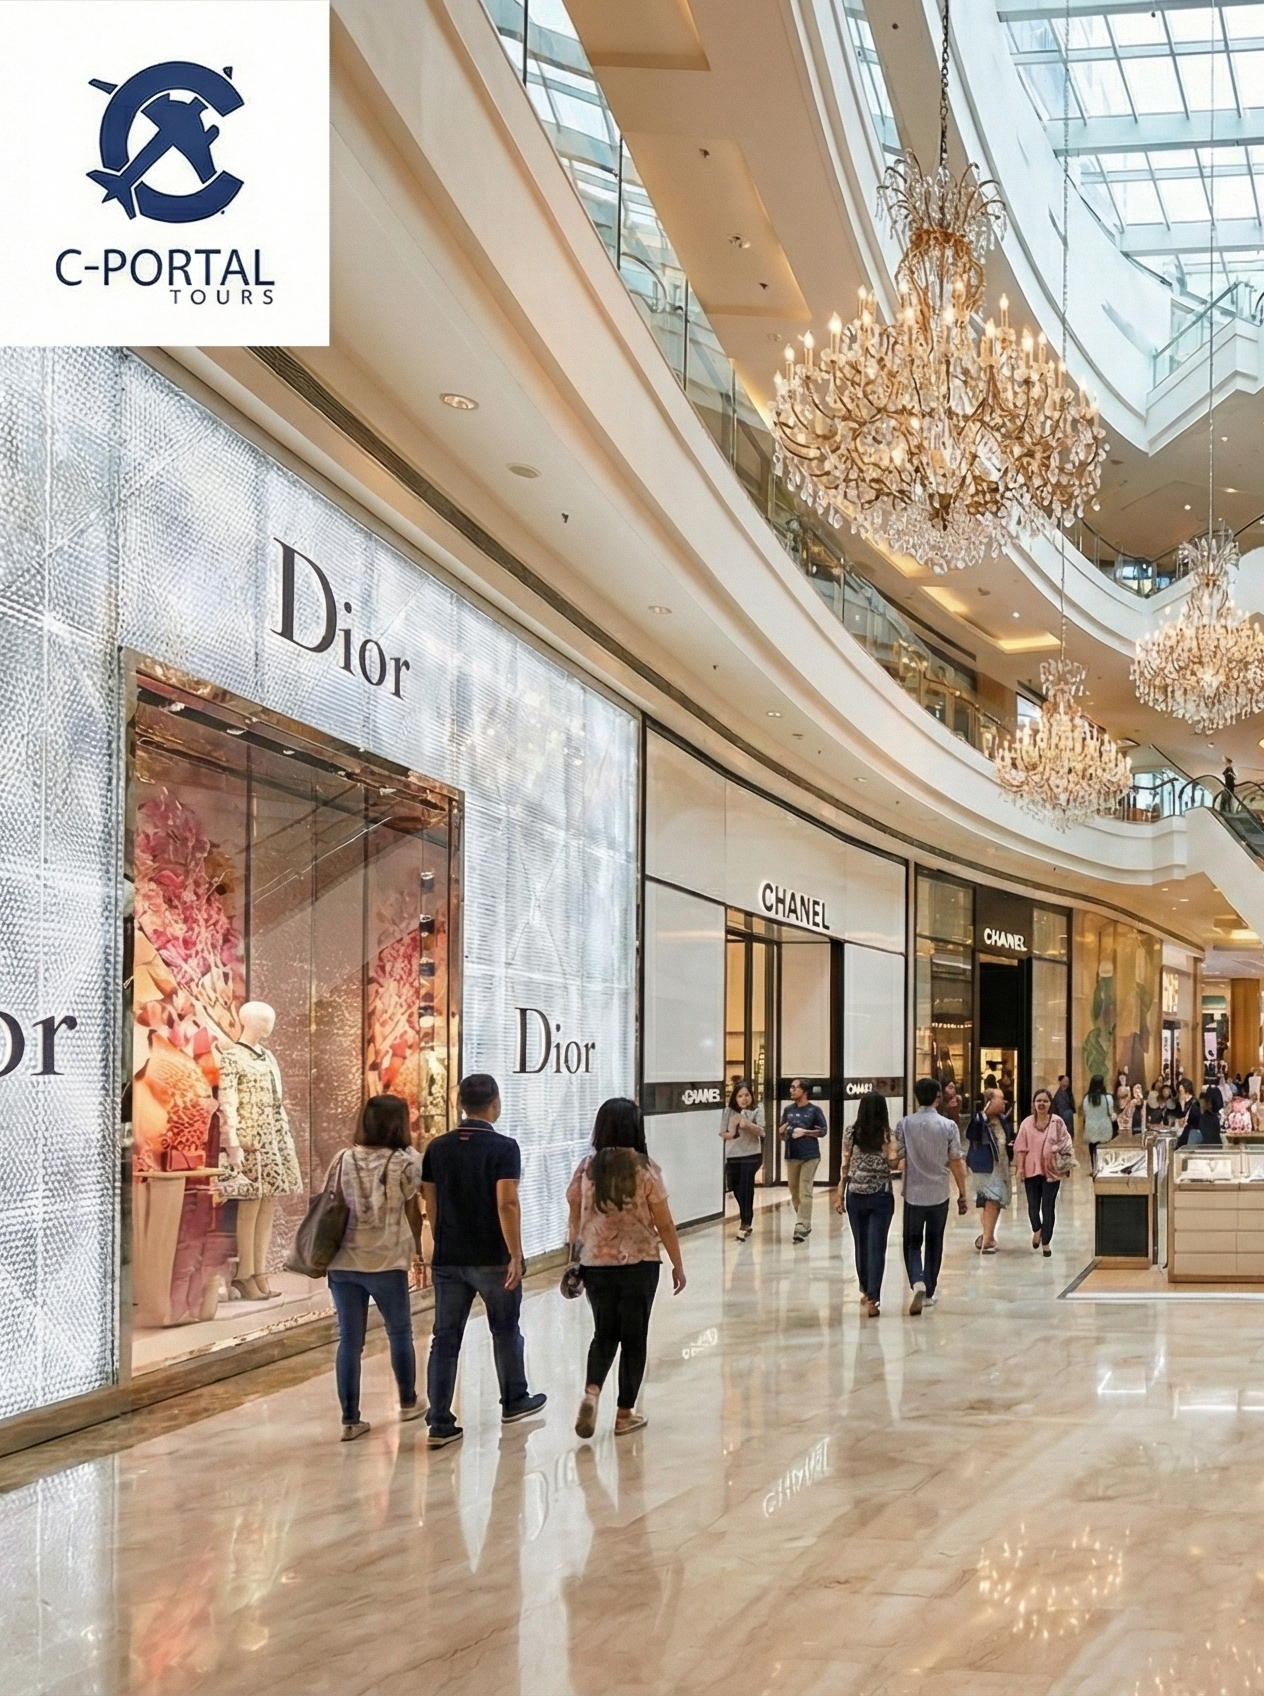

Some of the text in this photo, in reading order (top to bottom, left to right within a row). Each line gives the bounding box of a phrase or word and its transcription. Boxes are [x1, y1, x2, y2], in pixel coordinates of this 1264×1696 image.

[270, 537, 410, 701] Dior
[761, 882, 830, 931] CHANEL
[512, 1006, 596, 1075] Dior
